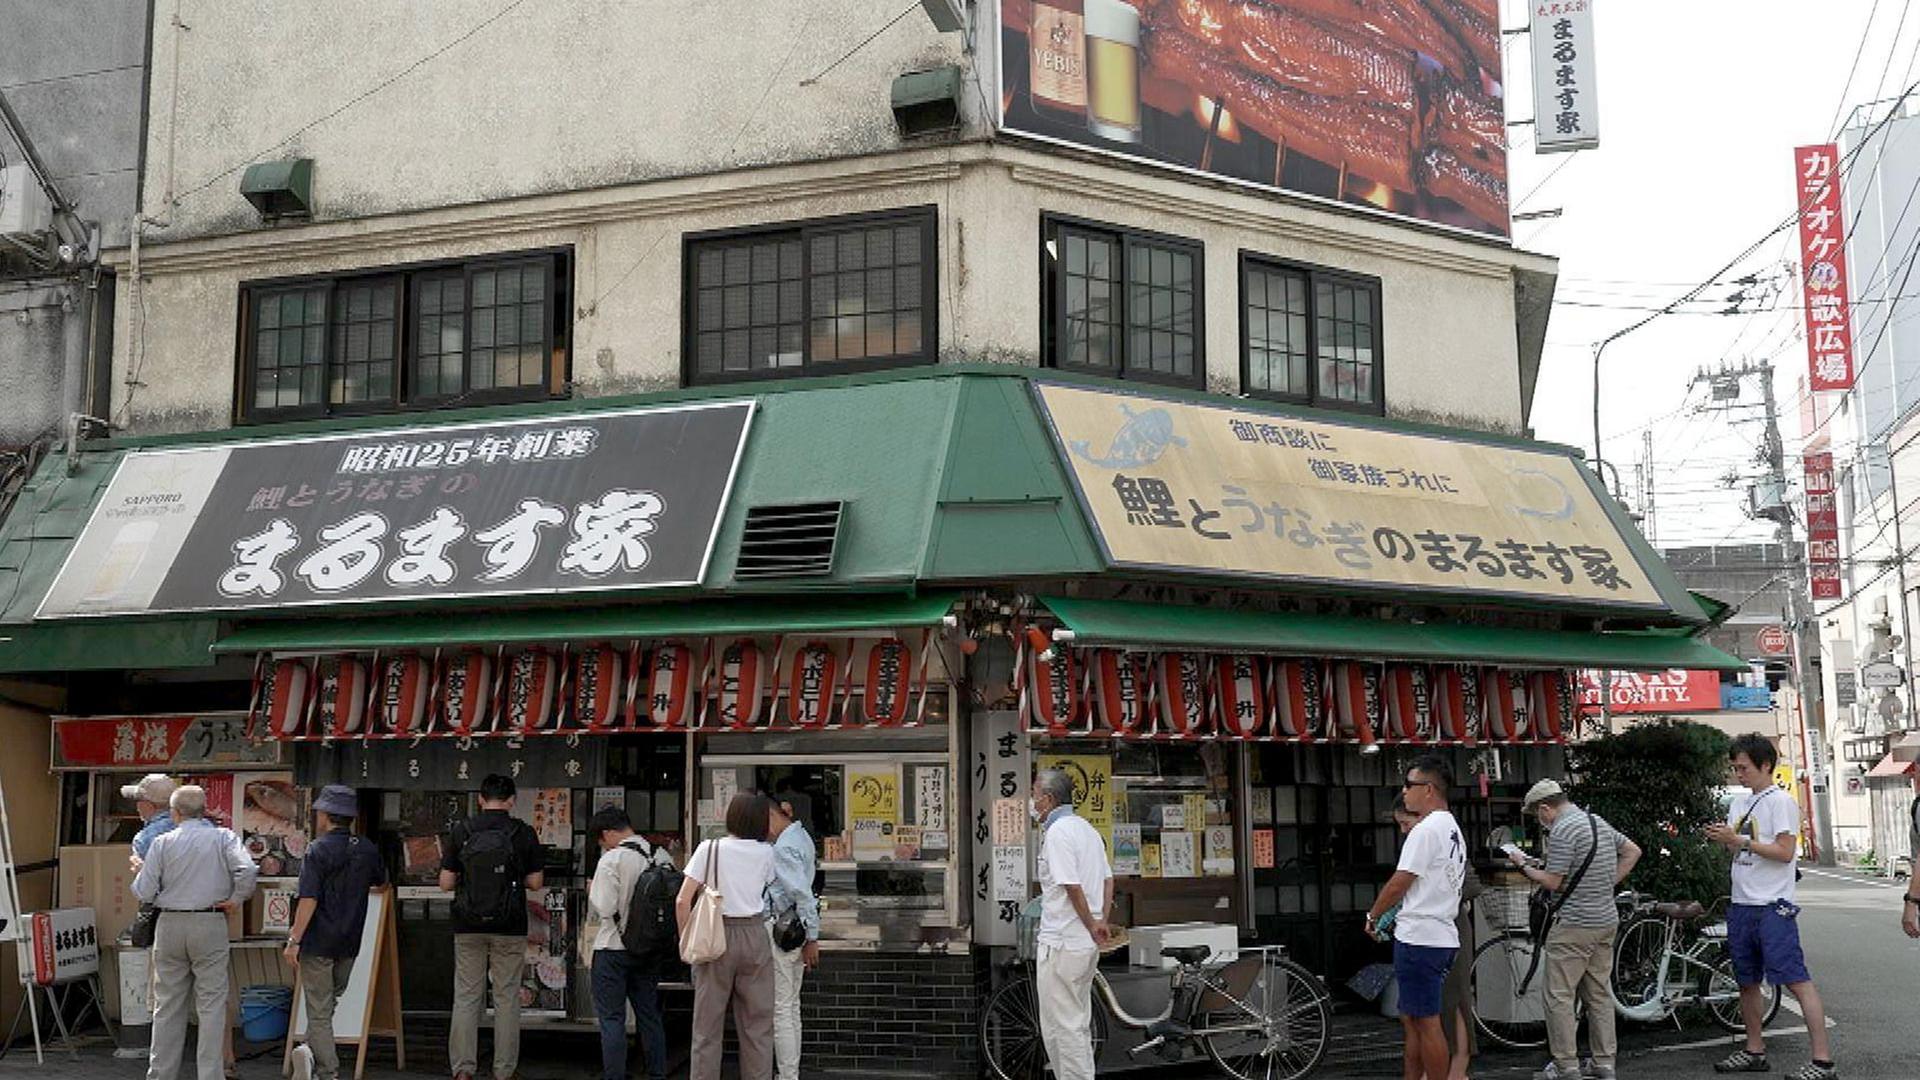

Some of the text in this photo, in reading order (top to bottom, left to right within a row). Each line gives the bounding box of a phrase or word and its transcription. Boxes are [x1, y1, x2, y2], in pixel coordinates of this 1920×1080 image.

[1552, 18, 1580, 133] まるます家
[337, 427, 600, 473] 昭和25年創業
[1228, 418, 1338, 453] 御商談に
[246, 472, 478, 512] 鯉とうなぎの
[1307, 457, 1459, 495] 御家族づれに
[122, 492, 183, 506] SAPPORO
[217, 489, 666, 597] まるます家
[1112, 473, 1631, 590] 鯉とうなぎのまるます家
[113, 720, 170, 763] 蒲焼
[1090, 769, 1106, 812] 弁当
[998, 731, 1021, 923] まる家
